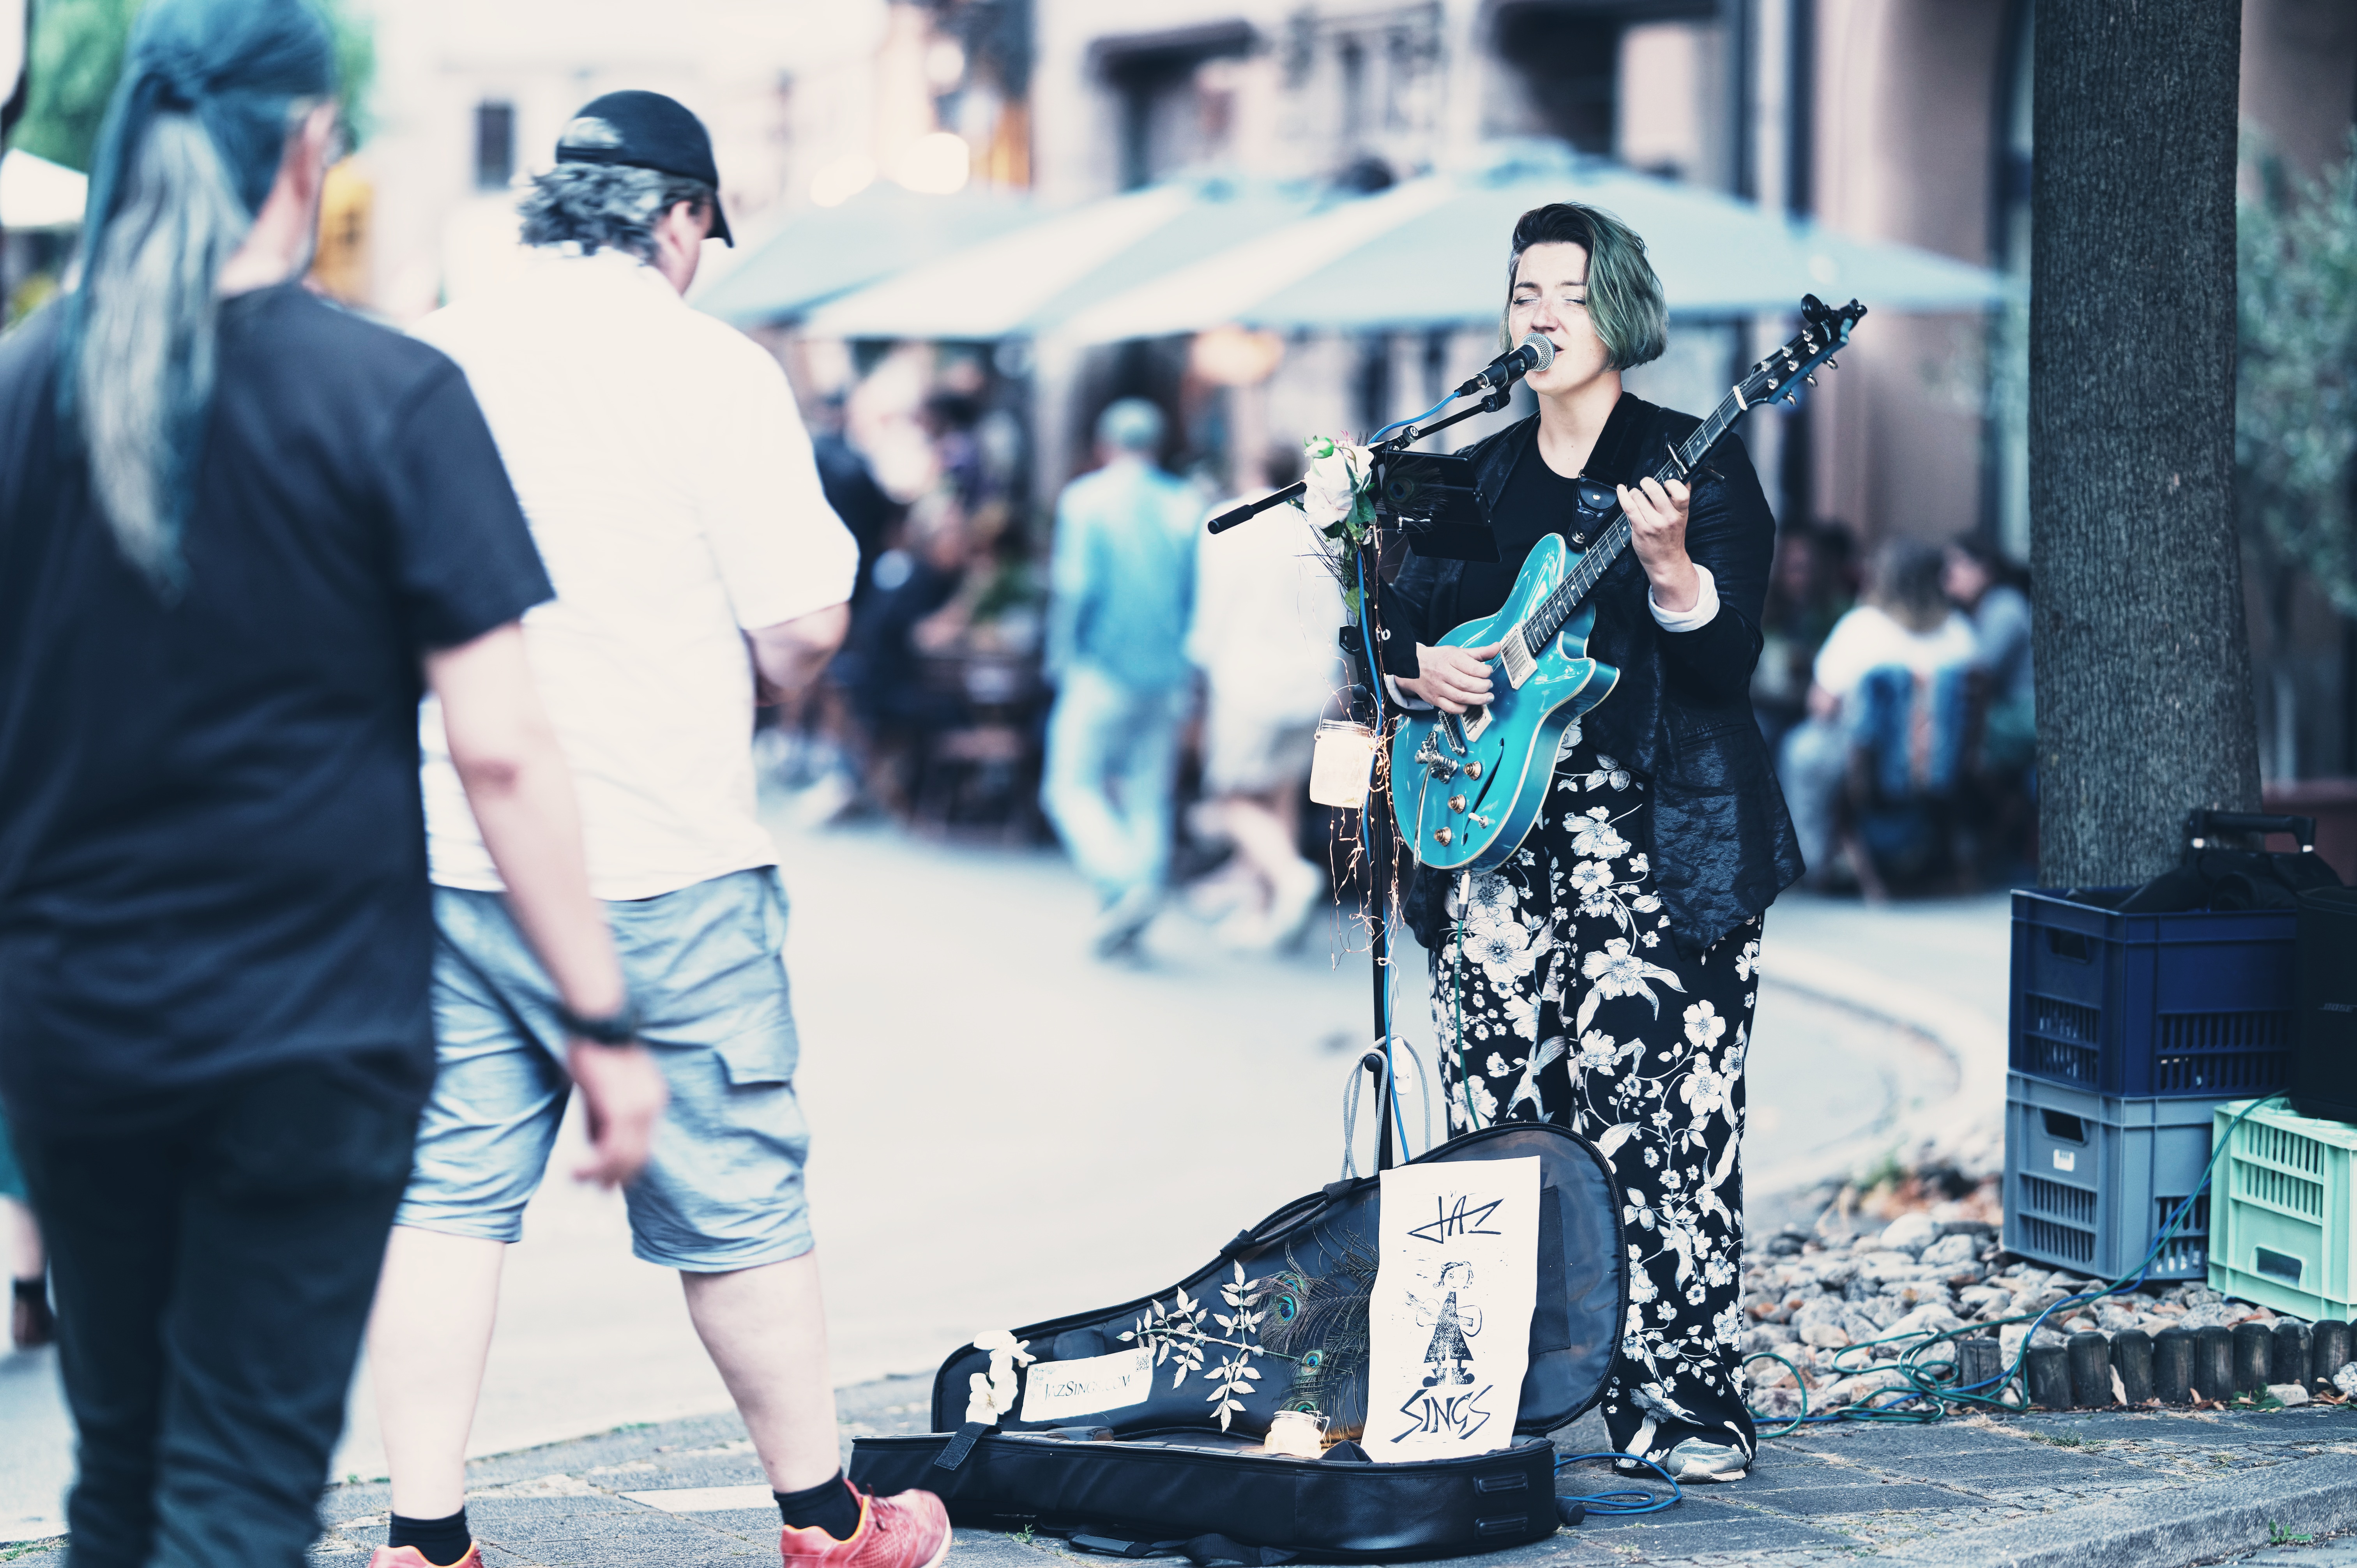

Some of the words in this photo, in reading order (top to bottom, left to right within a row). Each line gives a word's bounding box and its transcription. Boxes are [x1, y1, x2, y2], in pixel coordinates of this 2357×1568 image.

[2323, 1003, 2353, 1013] BOSE
[1406, 1195, 1505, 1244] JAZ
[1390, 1384, 1493, 1443] SINGS
